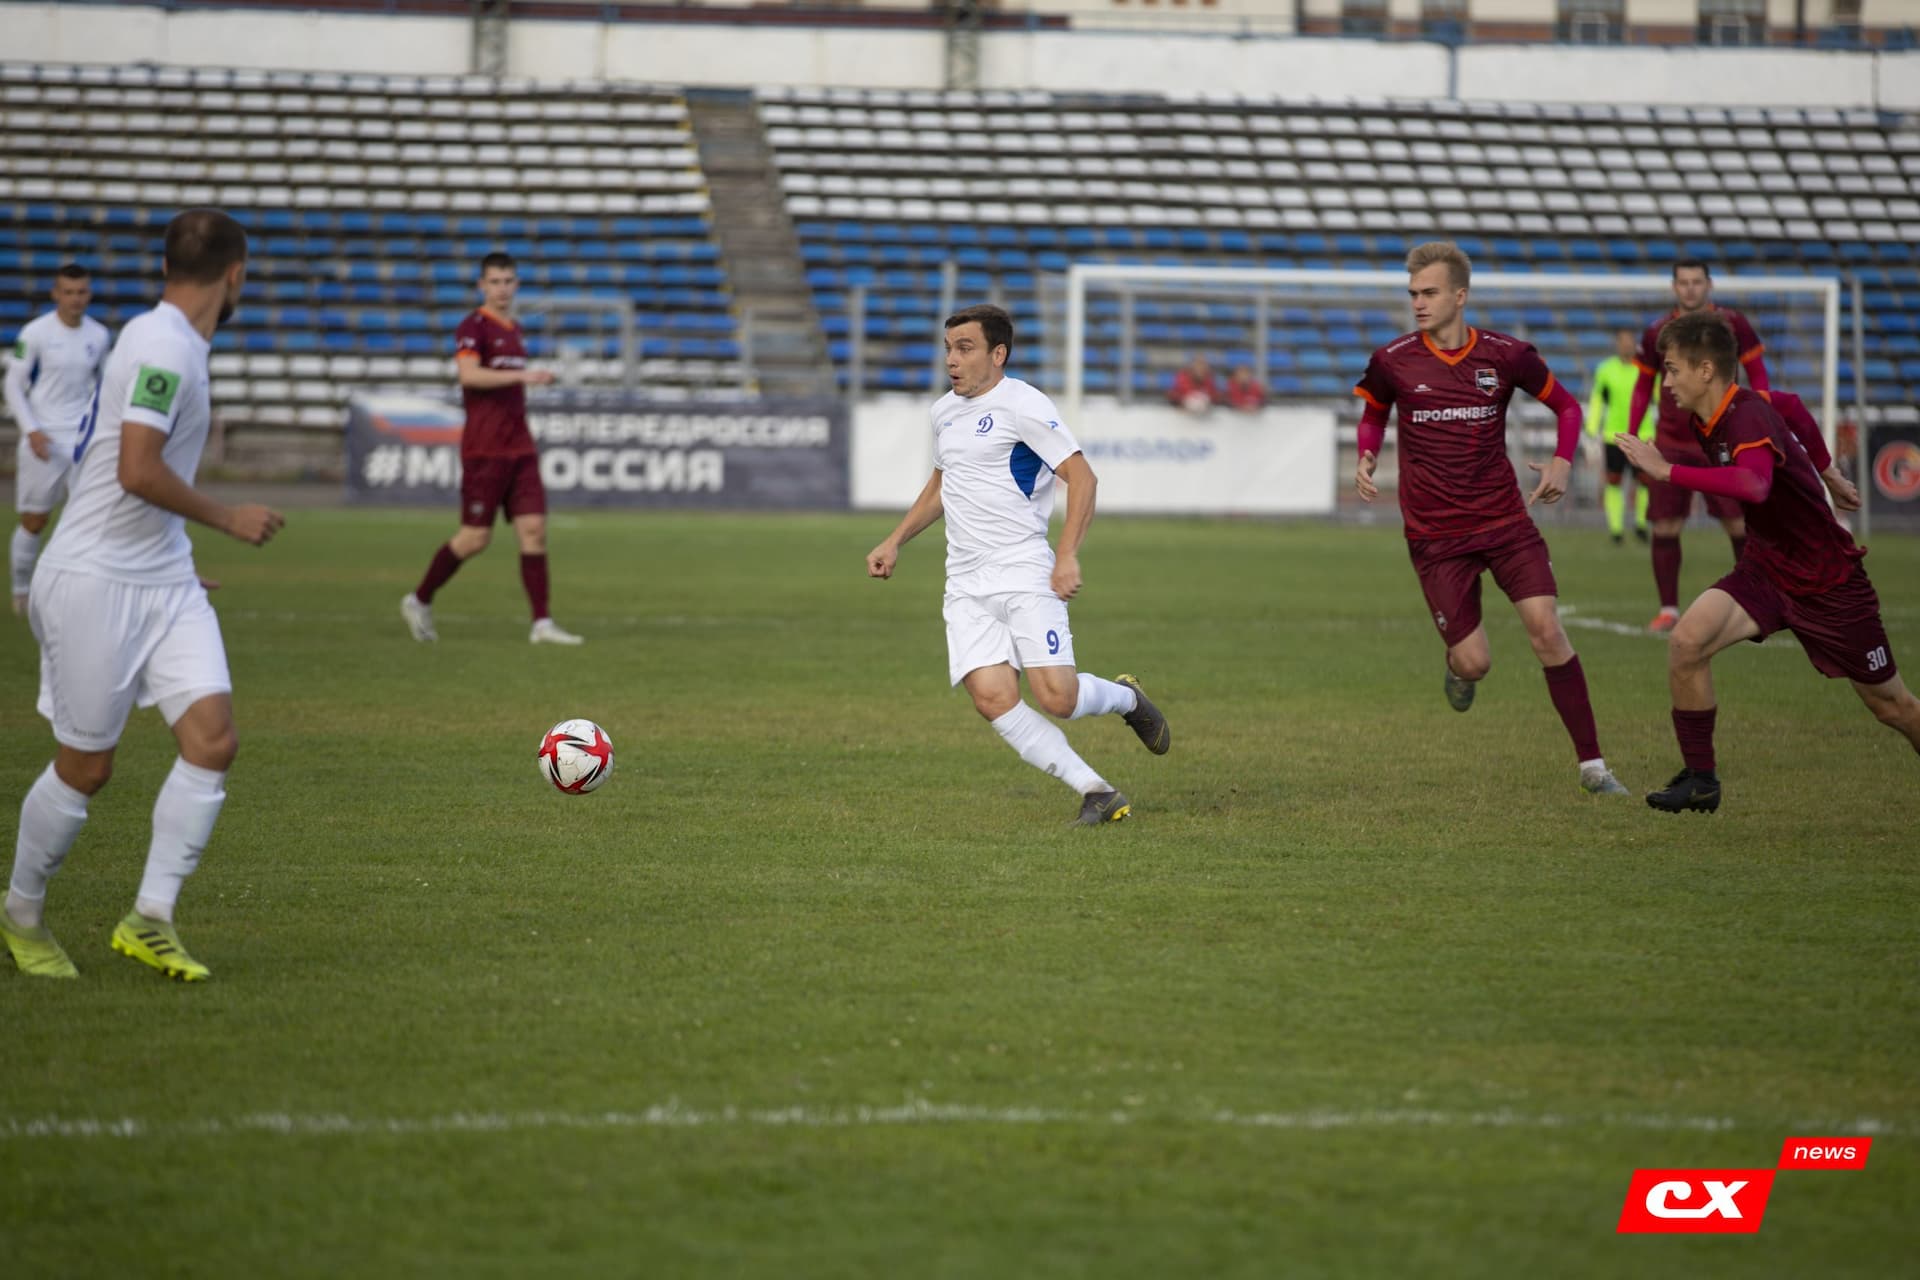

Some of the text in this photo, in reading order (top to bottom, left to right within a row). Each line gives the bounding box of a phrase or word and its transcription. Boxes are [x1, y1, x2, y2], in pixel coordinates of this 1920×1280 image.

[1412, 406, 1498, 422] ПРОДИНВЕС
[1046, 629, 1060, 655] 9
[1867, 646, 1888, 671] 30
